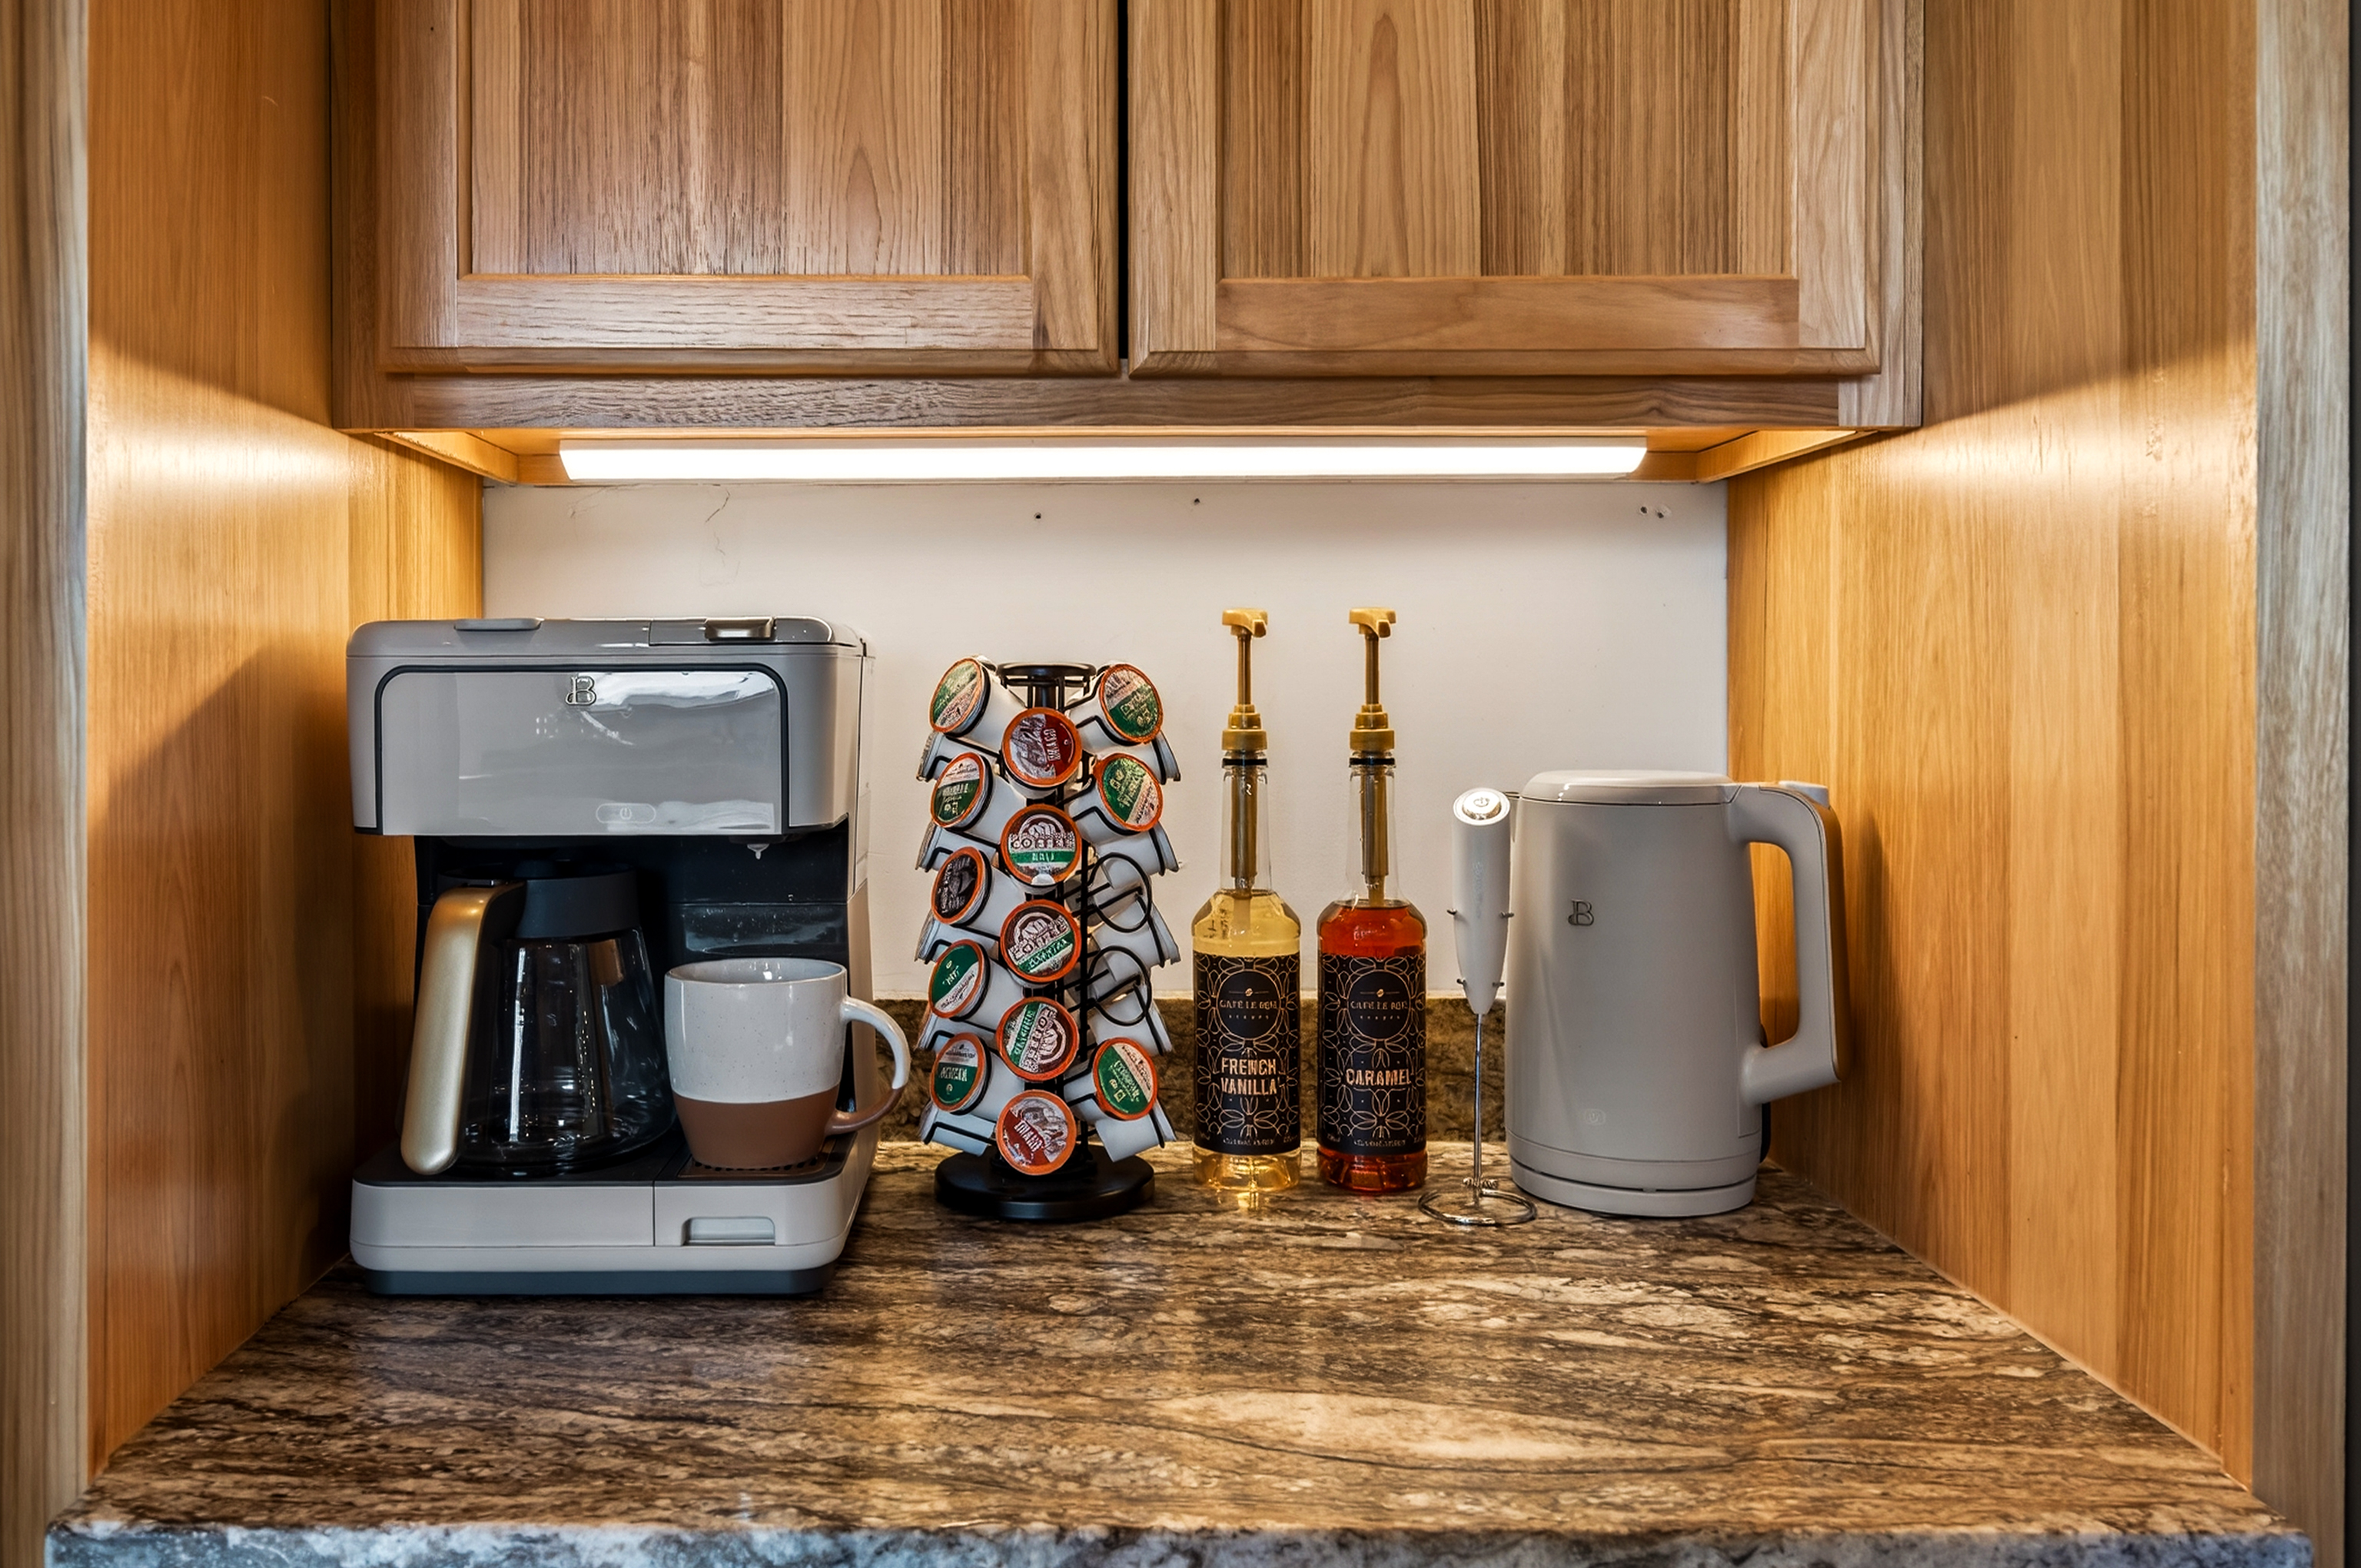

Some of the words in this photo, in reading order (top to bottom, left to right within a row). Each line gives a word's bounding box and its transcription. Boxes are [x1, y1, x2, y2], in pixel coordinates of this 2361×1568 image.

[1222, 1057, 1276, 1075] FRENCH
[1346, 1068, 1411, 1086] CARAMEL
[1220, 1077, 1277, 1096] VANILLA
